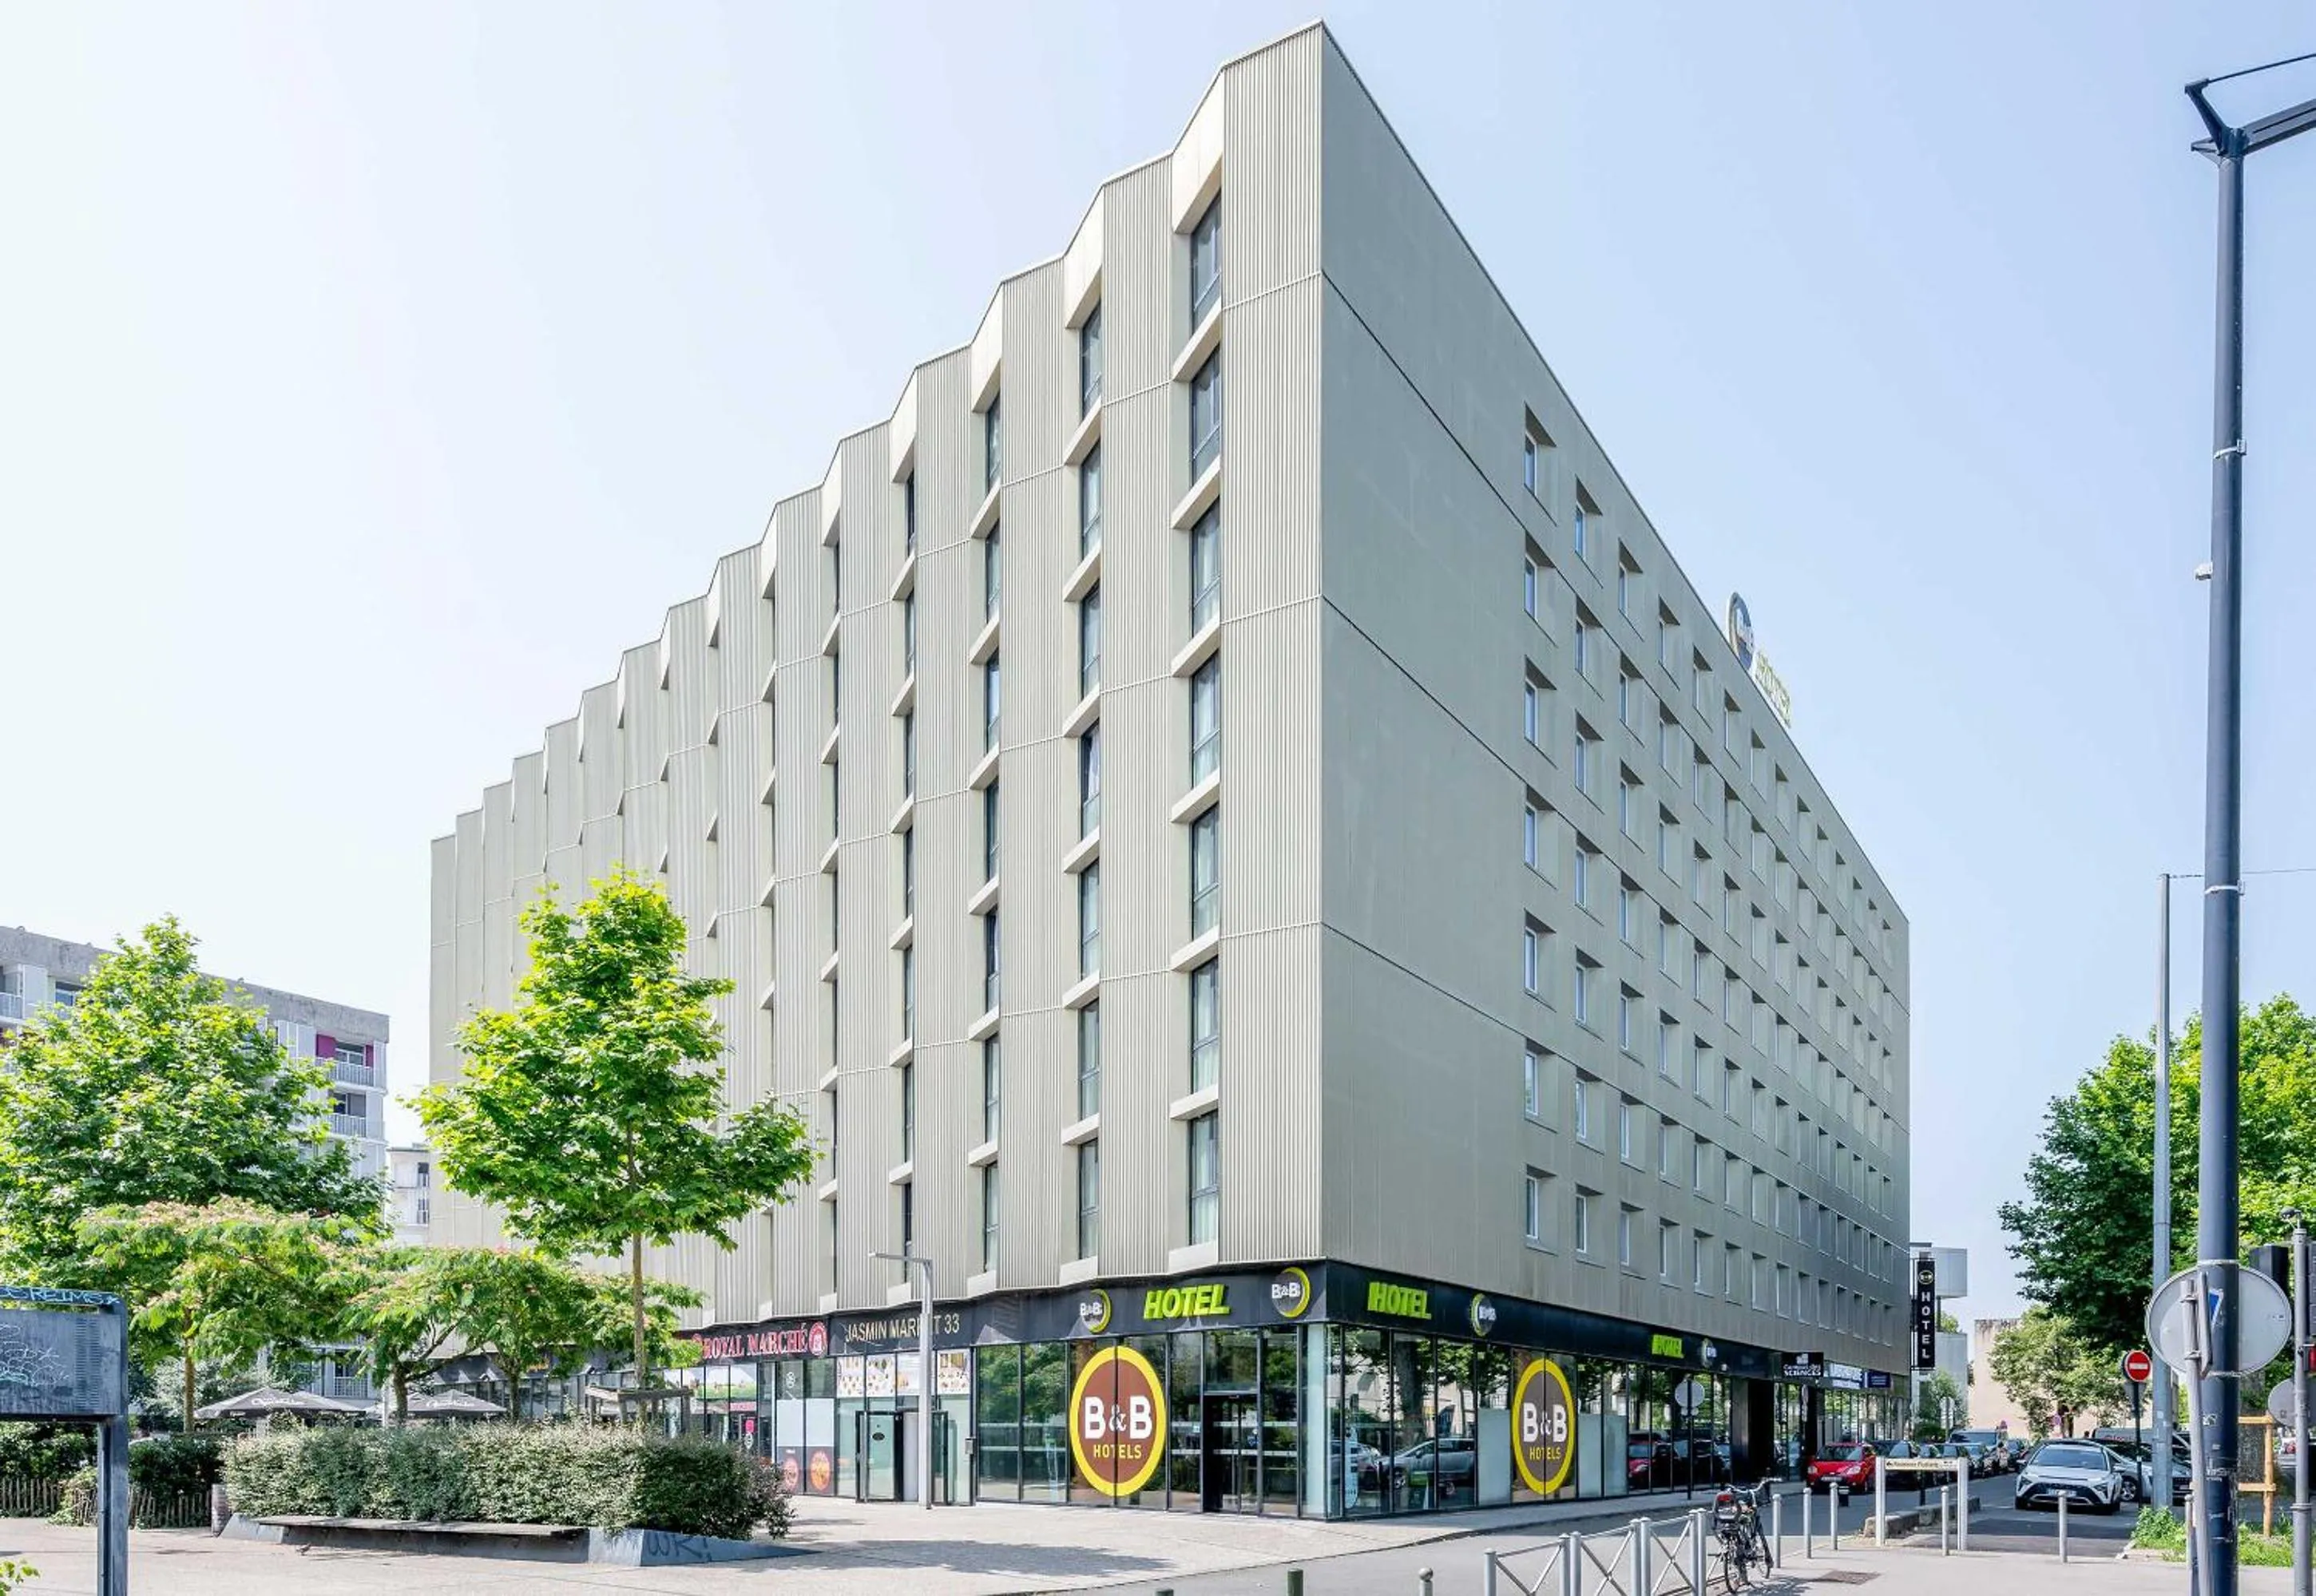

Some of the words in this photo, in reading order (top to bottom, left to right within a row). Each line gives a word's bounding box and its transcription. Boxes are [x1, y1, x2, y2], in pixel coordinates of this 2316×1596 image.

[1143, 1283, 1231, 1320] HOTEL
[1271, 1281, 1301, 1299] B&B
[1367, 1281, 1432, 1321] HOTEL
[845, 1321, 887, 1343] JASMIN
[889, 1314, 942, 1339] MART
[944, 1313, 960, 1335] 33
[1080, 1302, 1103, 1317] B&B
[1921, 1291, 1931, 1359] HOTEL
[702, 1334, 744, 1360] ROYAL
[747, 1322, 808, 1356] MARCHÉ
[1085, 1395, 1152, 1440] B&B
[1523, 1402, 1568, 1443] B&B
[1093, 1444, 1142, 1459] HOTELS
[1529, 1446, 1561, 1460] HOTELS
